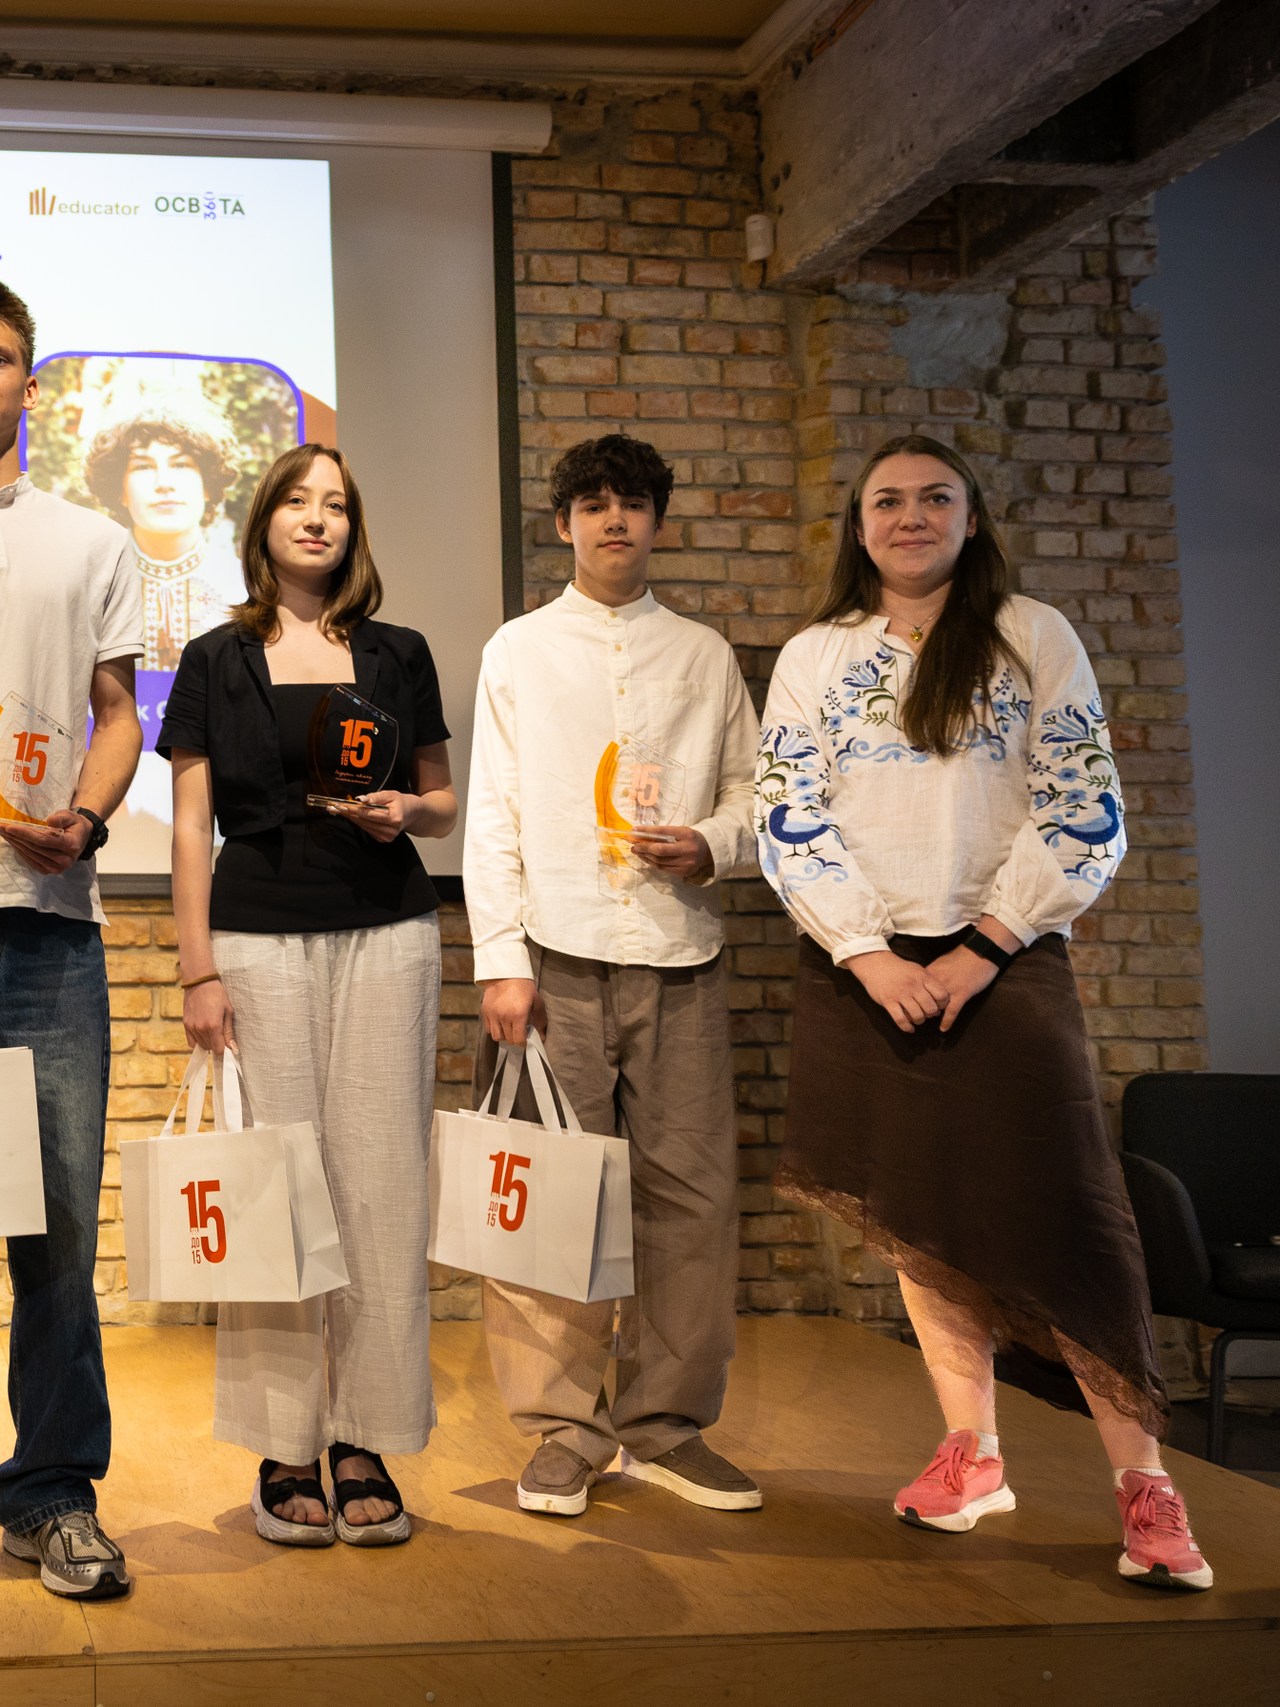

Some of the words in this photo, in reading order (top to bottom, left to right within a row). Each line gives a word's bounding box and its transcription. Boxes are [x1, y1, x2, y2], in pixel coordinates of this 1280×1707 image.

[58, 200, 140, 216] educator
[13, 731, 50, 786] 15
[340, 718, 375, 769] 15
[630, 763, 662, 807] 15
[488, 1150, 531, 1232] 15
[180, 1180, 227, 1264] 15
[486, 1213, 497, 1227] 15
[191, 1249, 202, 1264] 15
